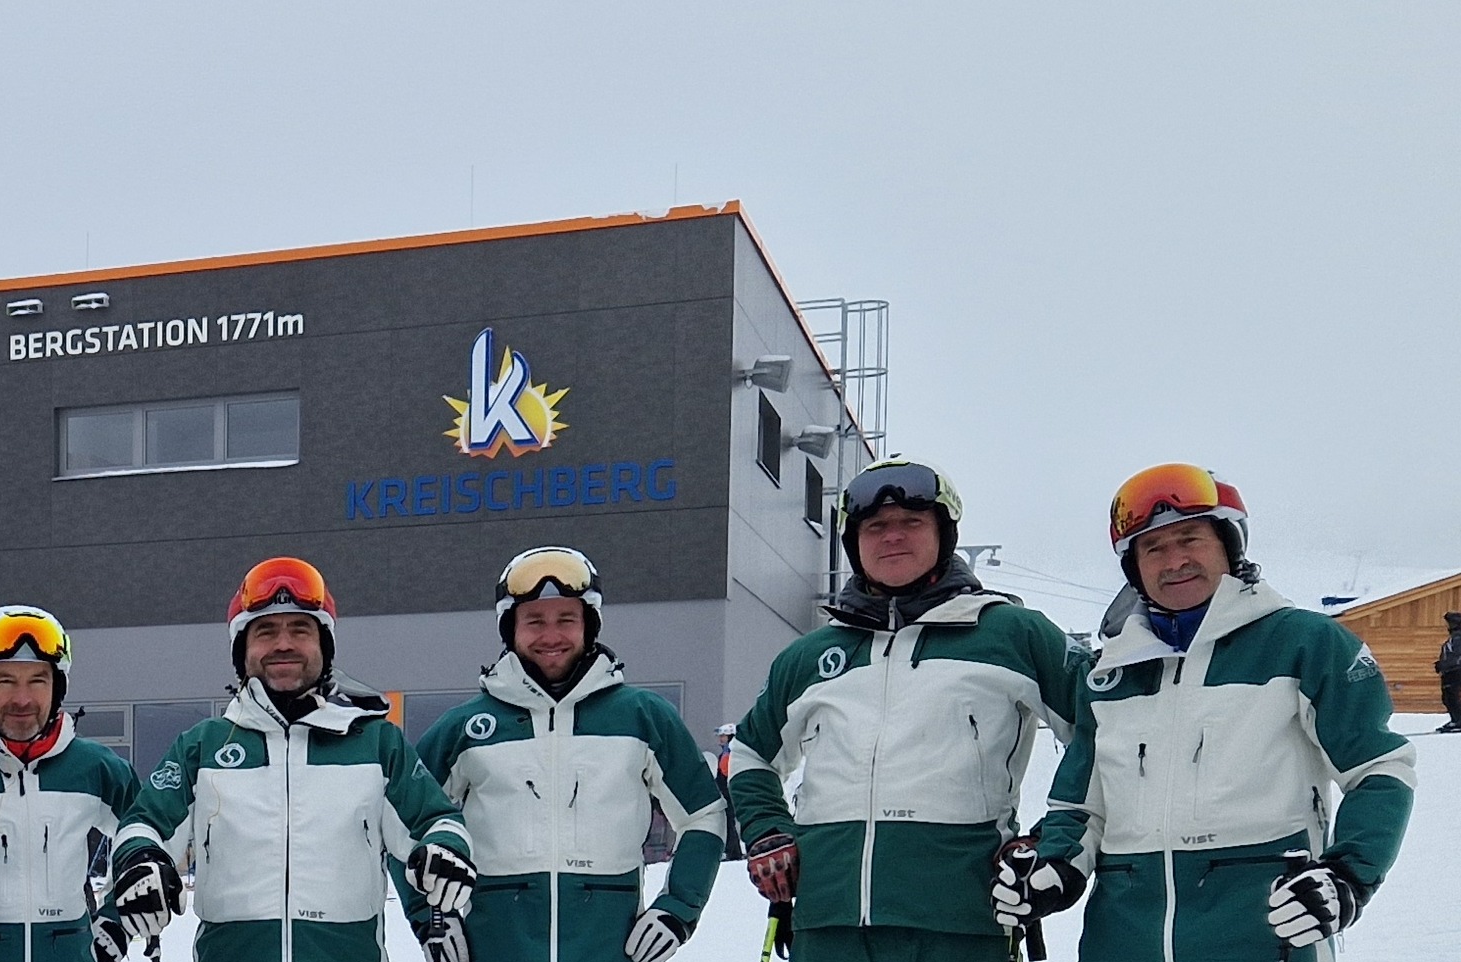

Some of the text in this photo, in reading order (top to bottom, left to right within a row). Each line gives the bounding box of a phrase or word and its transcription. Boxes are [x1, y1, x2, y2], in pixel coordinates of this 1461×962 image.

[9, 311, 305, 361] BERGSTATION 1771m
[346, 458, 677, 520] KREISCHBERG
